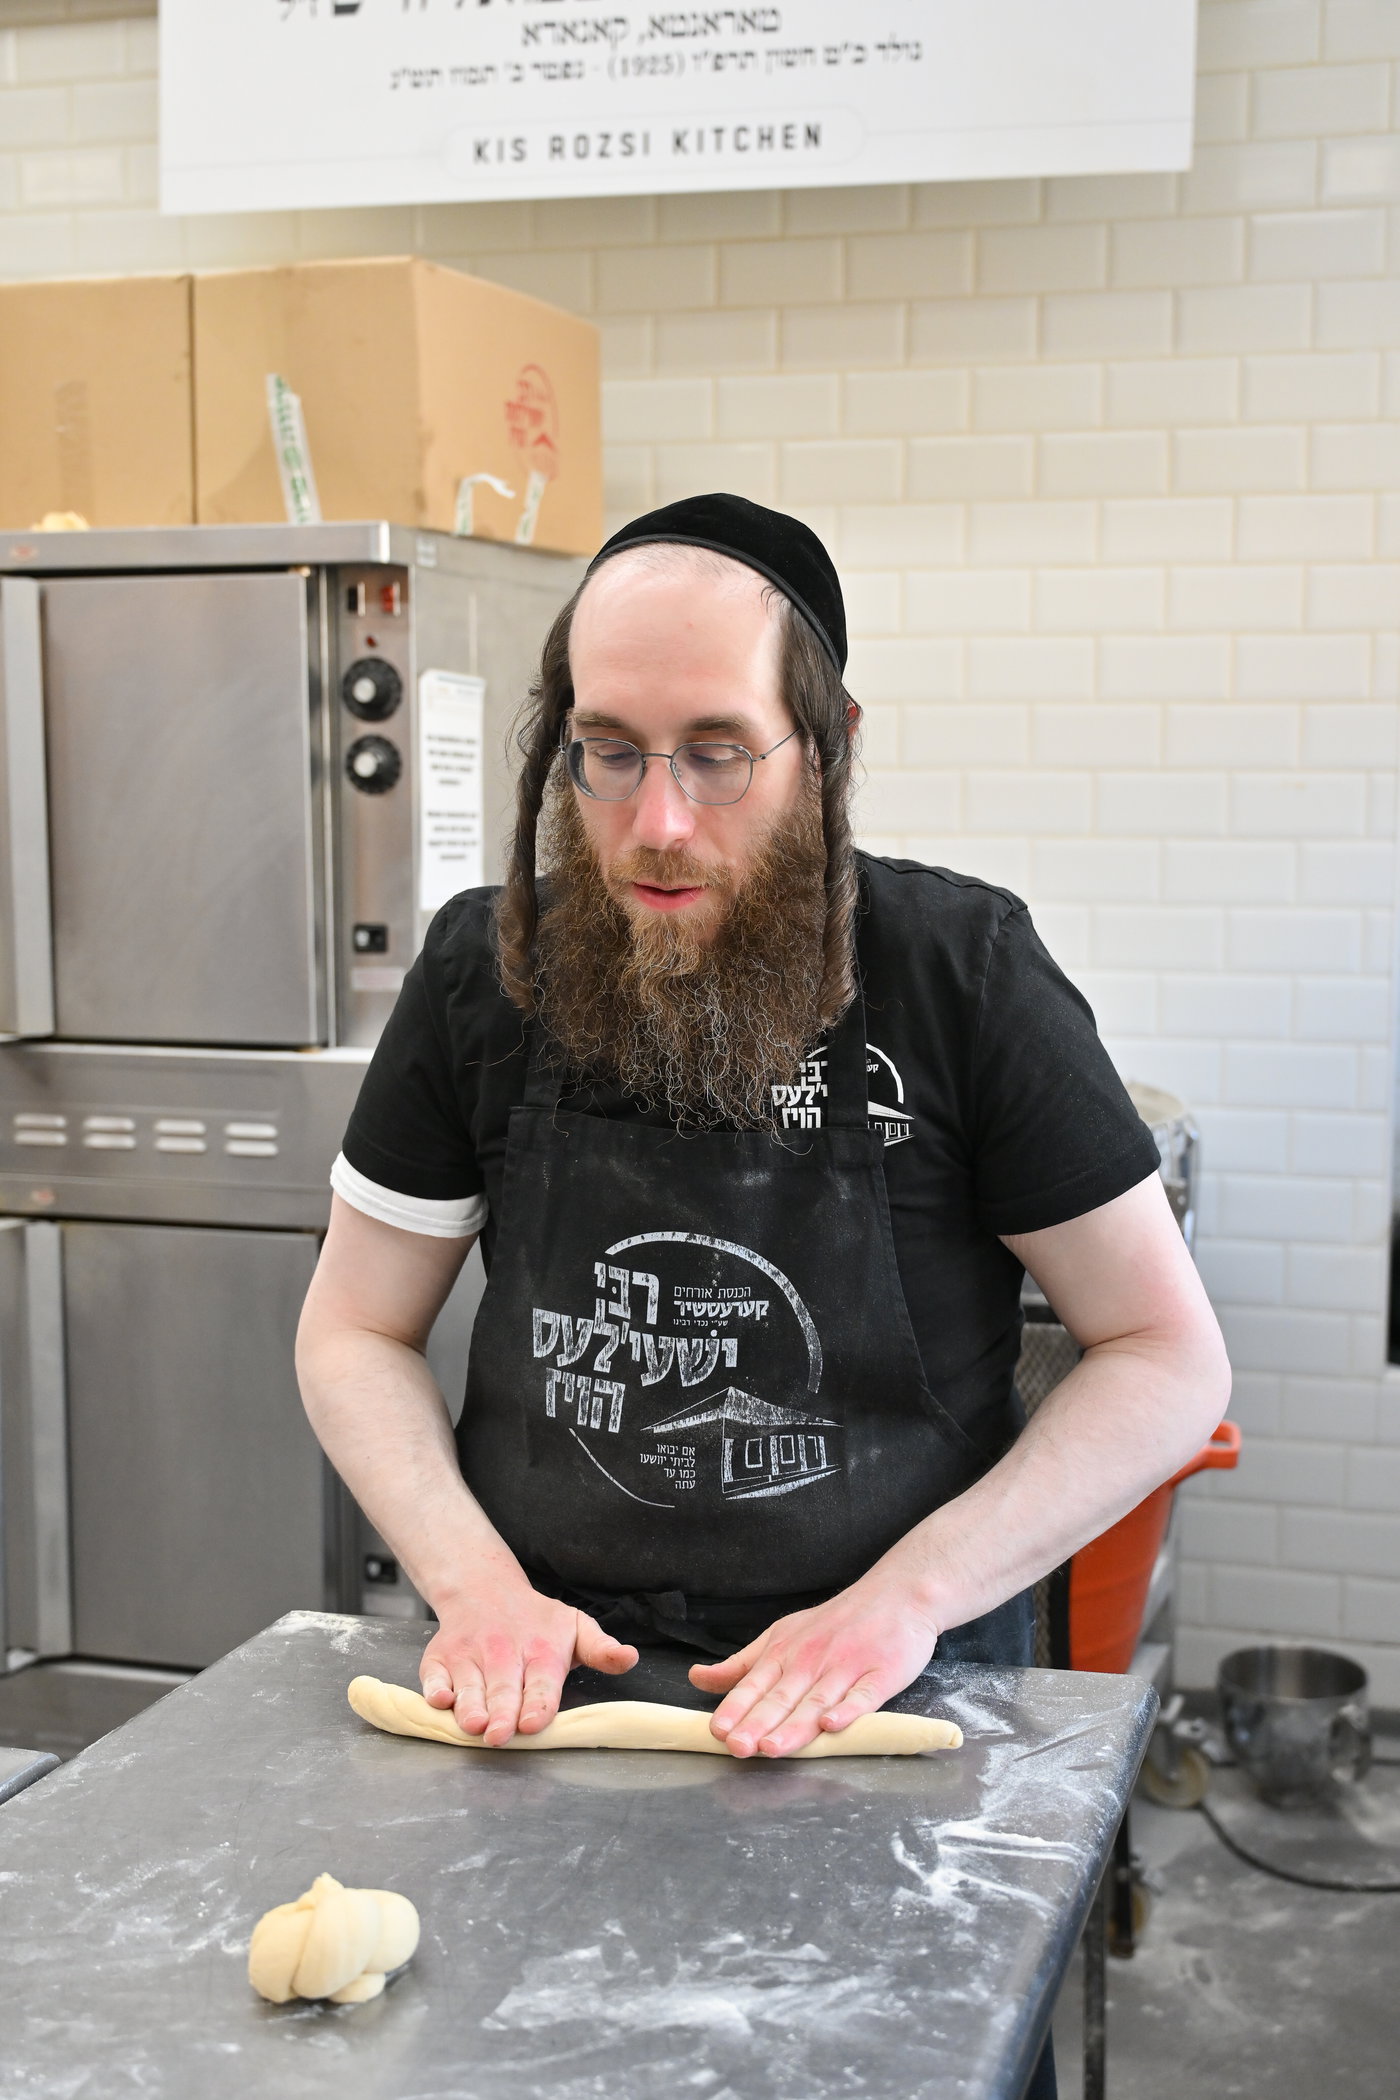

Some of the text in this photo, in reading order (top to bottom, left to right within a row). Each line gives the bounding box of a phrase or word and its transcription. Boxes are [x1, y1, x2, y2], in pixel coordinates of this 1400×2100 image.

[473, 123, 822, 165] KIS ROZSI KITCHEN
[673, 1285, 751, 1299] הכנסת אורחים
[545, 1366, 626, 1434] הויז
[656, 1443, 696, 1456] אם יבואו
[669, 1456, 696, 1468] לביתי
[663, 1467, 696, 1479] כמו עד
[674, 1480, 696, 1490] עתה
